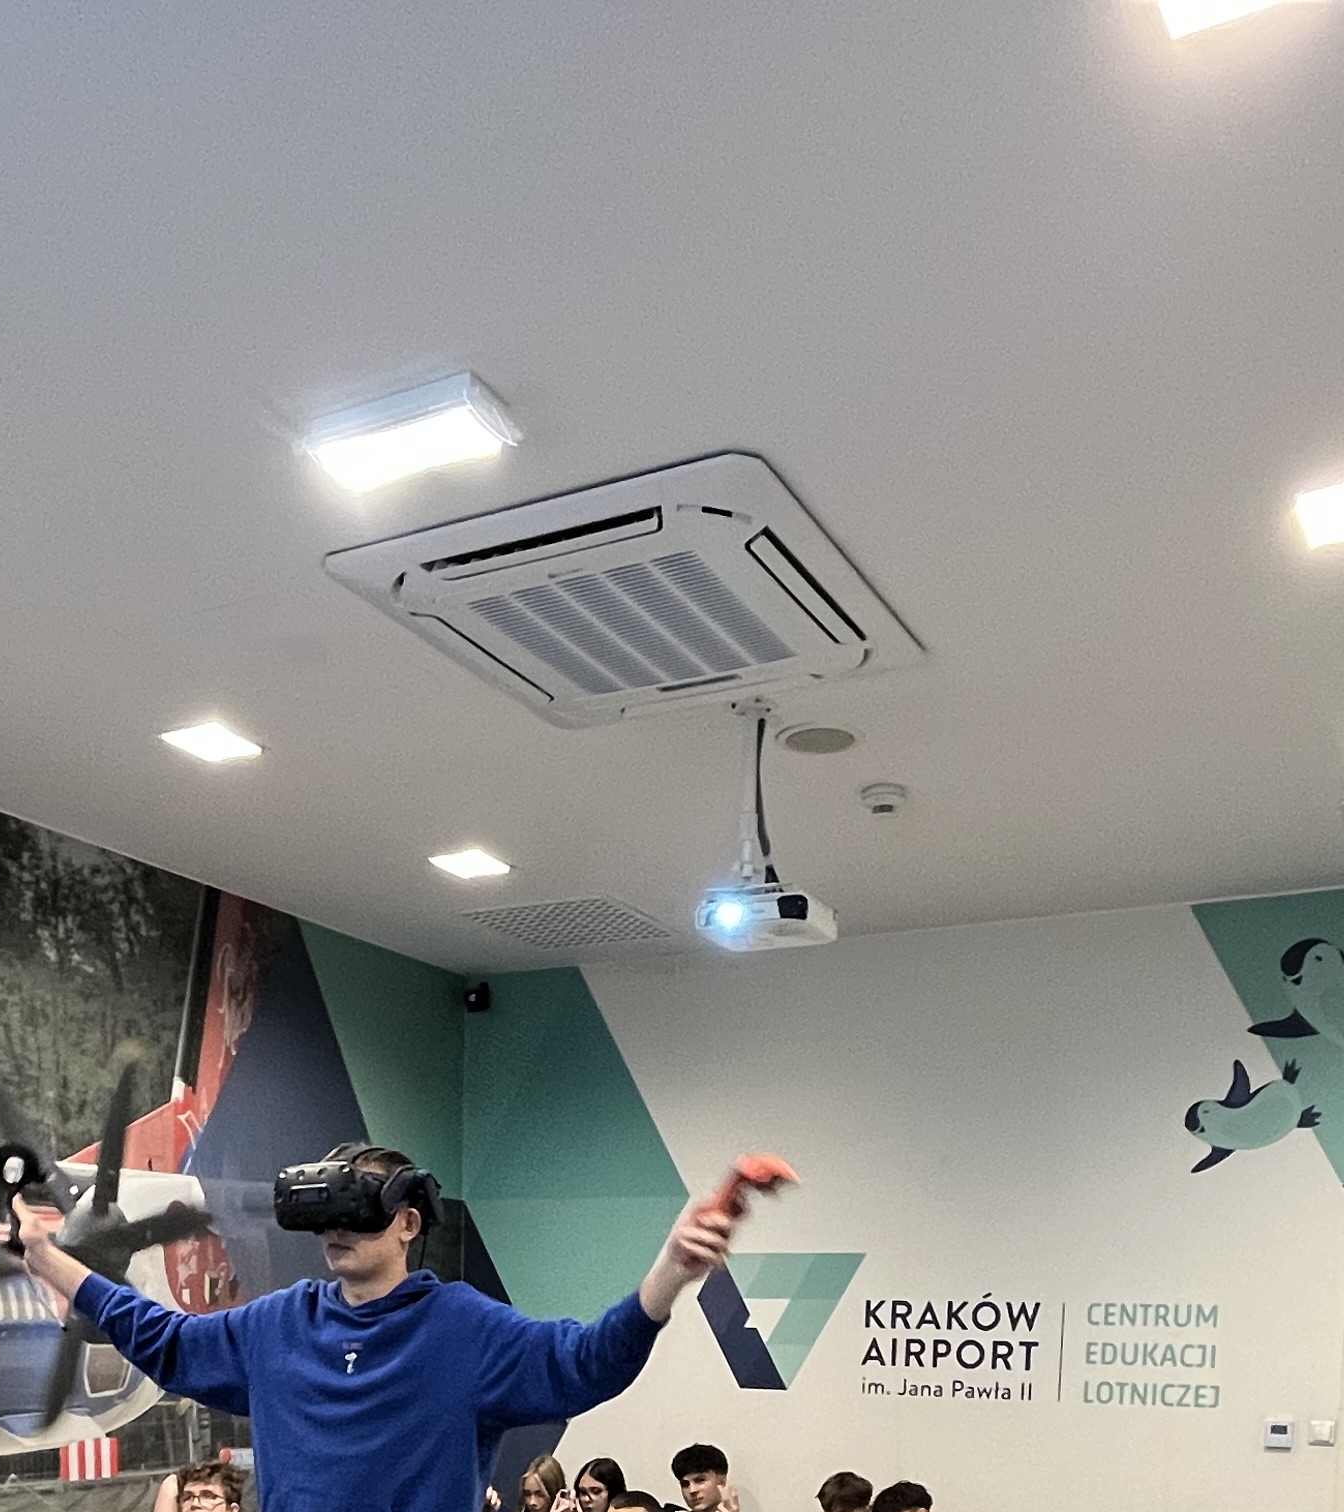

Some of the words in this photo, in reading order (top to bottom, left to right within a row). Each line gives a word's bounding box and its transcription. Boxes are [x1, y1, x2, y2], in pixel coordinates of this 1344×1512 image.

[864, 1292, 1041, 1332] KRAKÓW
[1087, 1302, 1219, 1328] CENTRUM
[861, 1337, 1039, 1371] AIRPORT
[1085, 1341, 1217, 1369] EDUKACJI
[861, 1377, 891, 1396] im.
[897, 1378, 943, 1398] Jana
[951, 1379, 1011, 1400] Pawła
[1020, 1382, 1032, 1401] II
[1083, 1380, 1220, 1408] LOTNICZEJ
